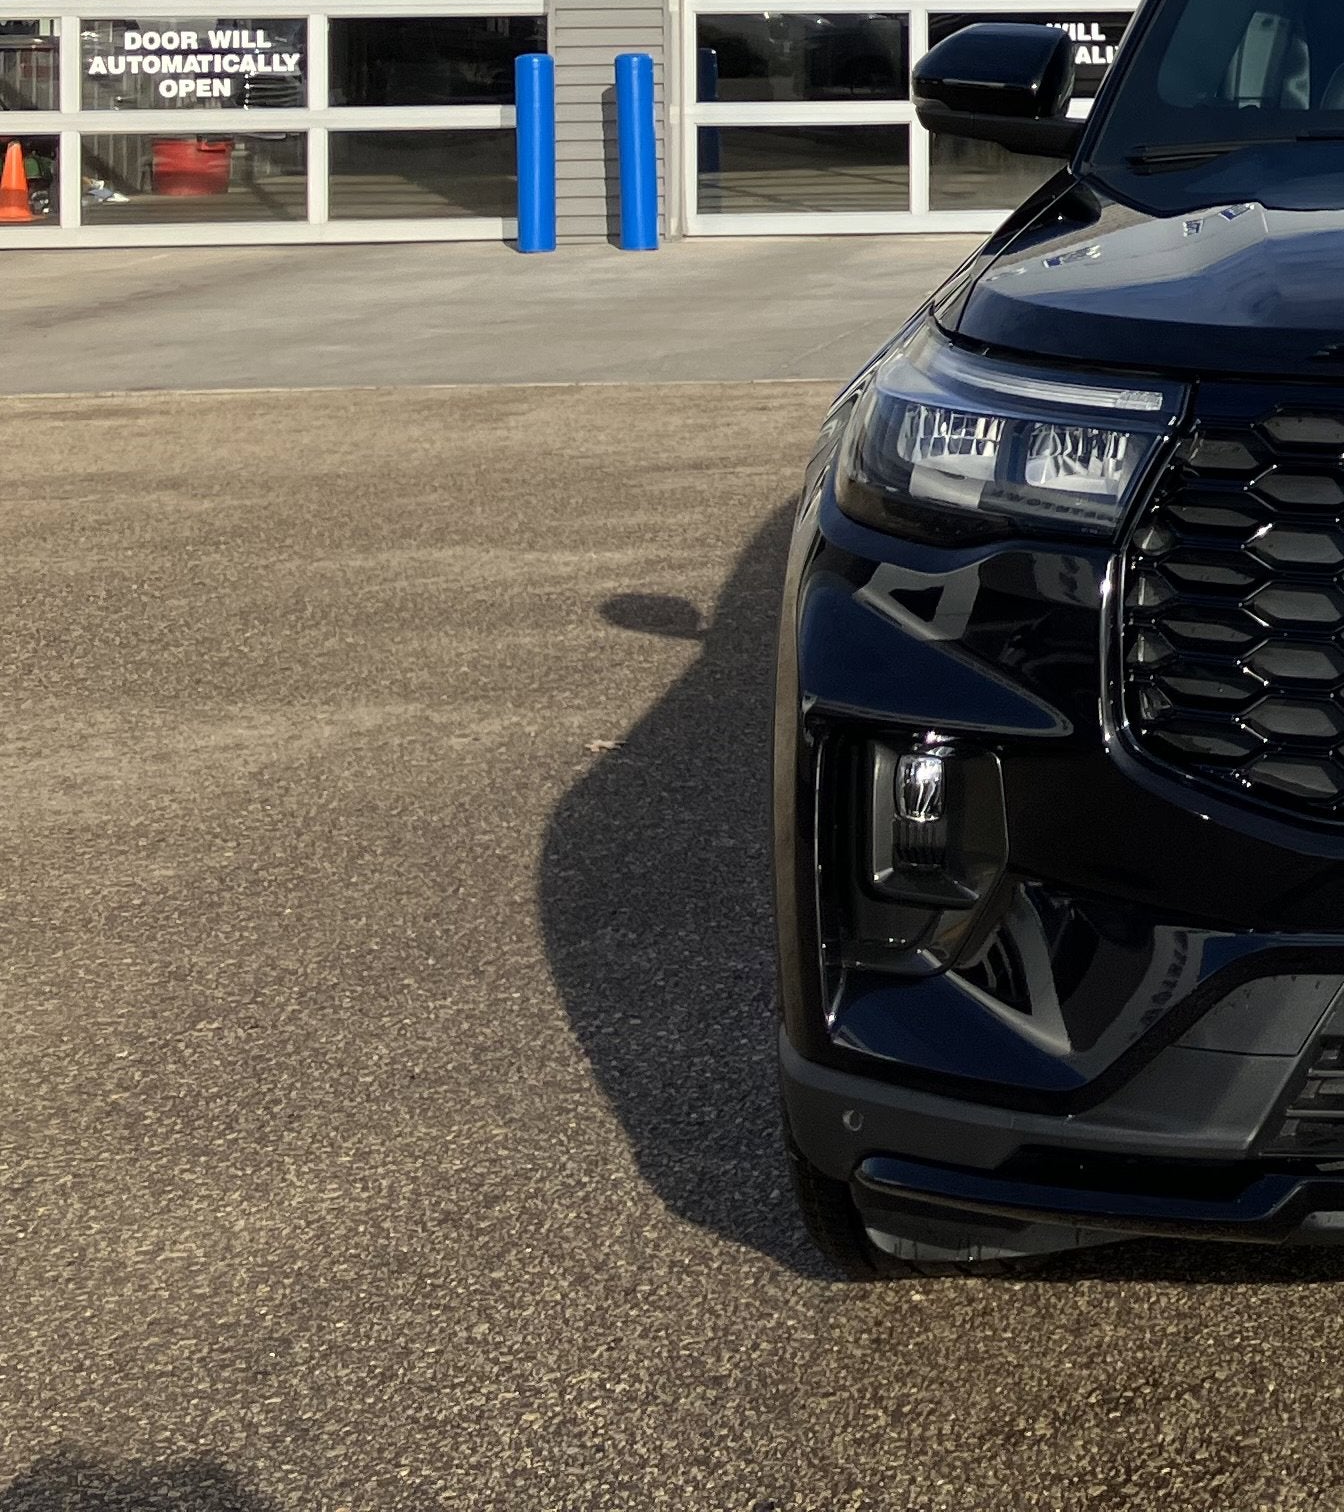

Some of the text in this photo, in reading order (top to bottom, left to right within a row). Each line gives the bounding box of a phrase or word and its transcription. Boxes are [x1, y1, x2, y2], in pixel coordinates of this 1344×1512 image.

[124, 29, 272, 50] DOOR WILL
[88, 53, 301, 75] AUTOMATICALLY
[158, 78, 232, 98] OPEN
